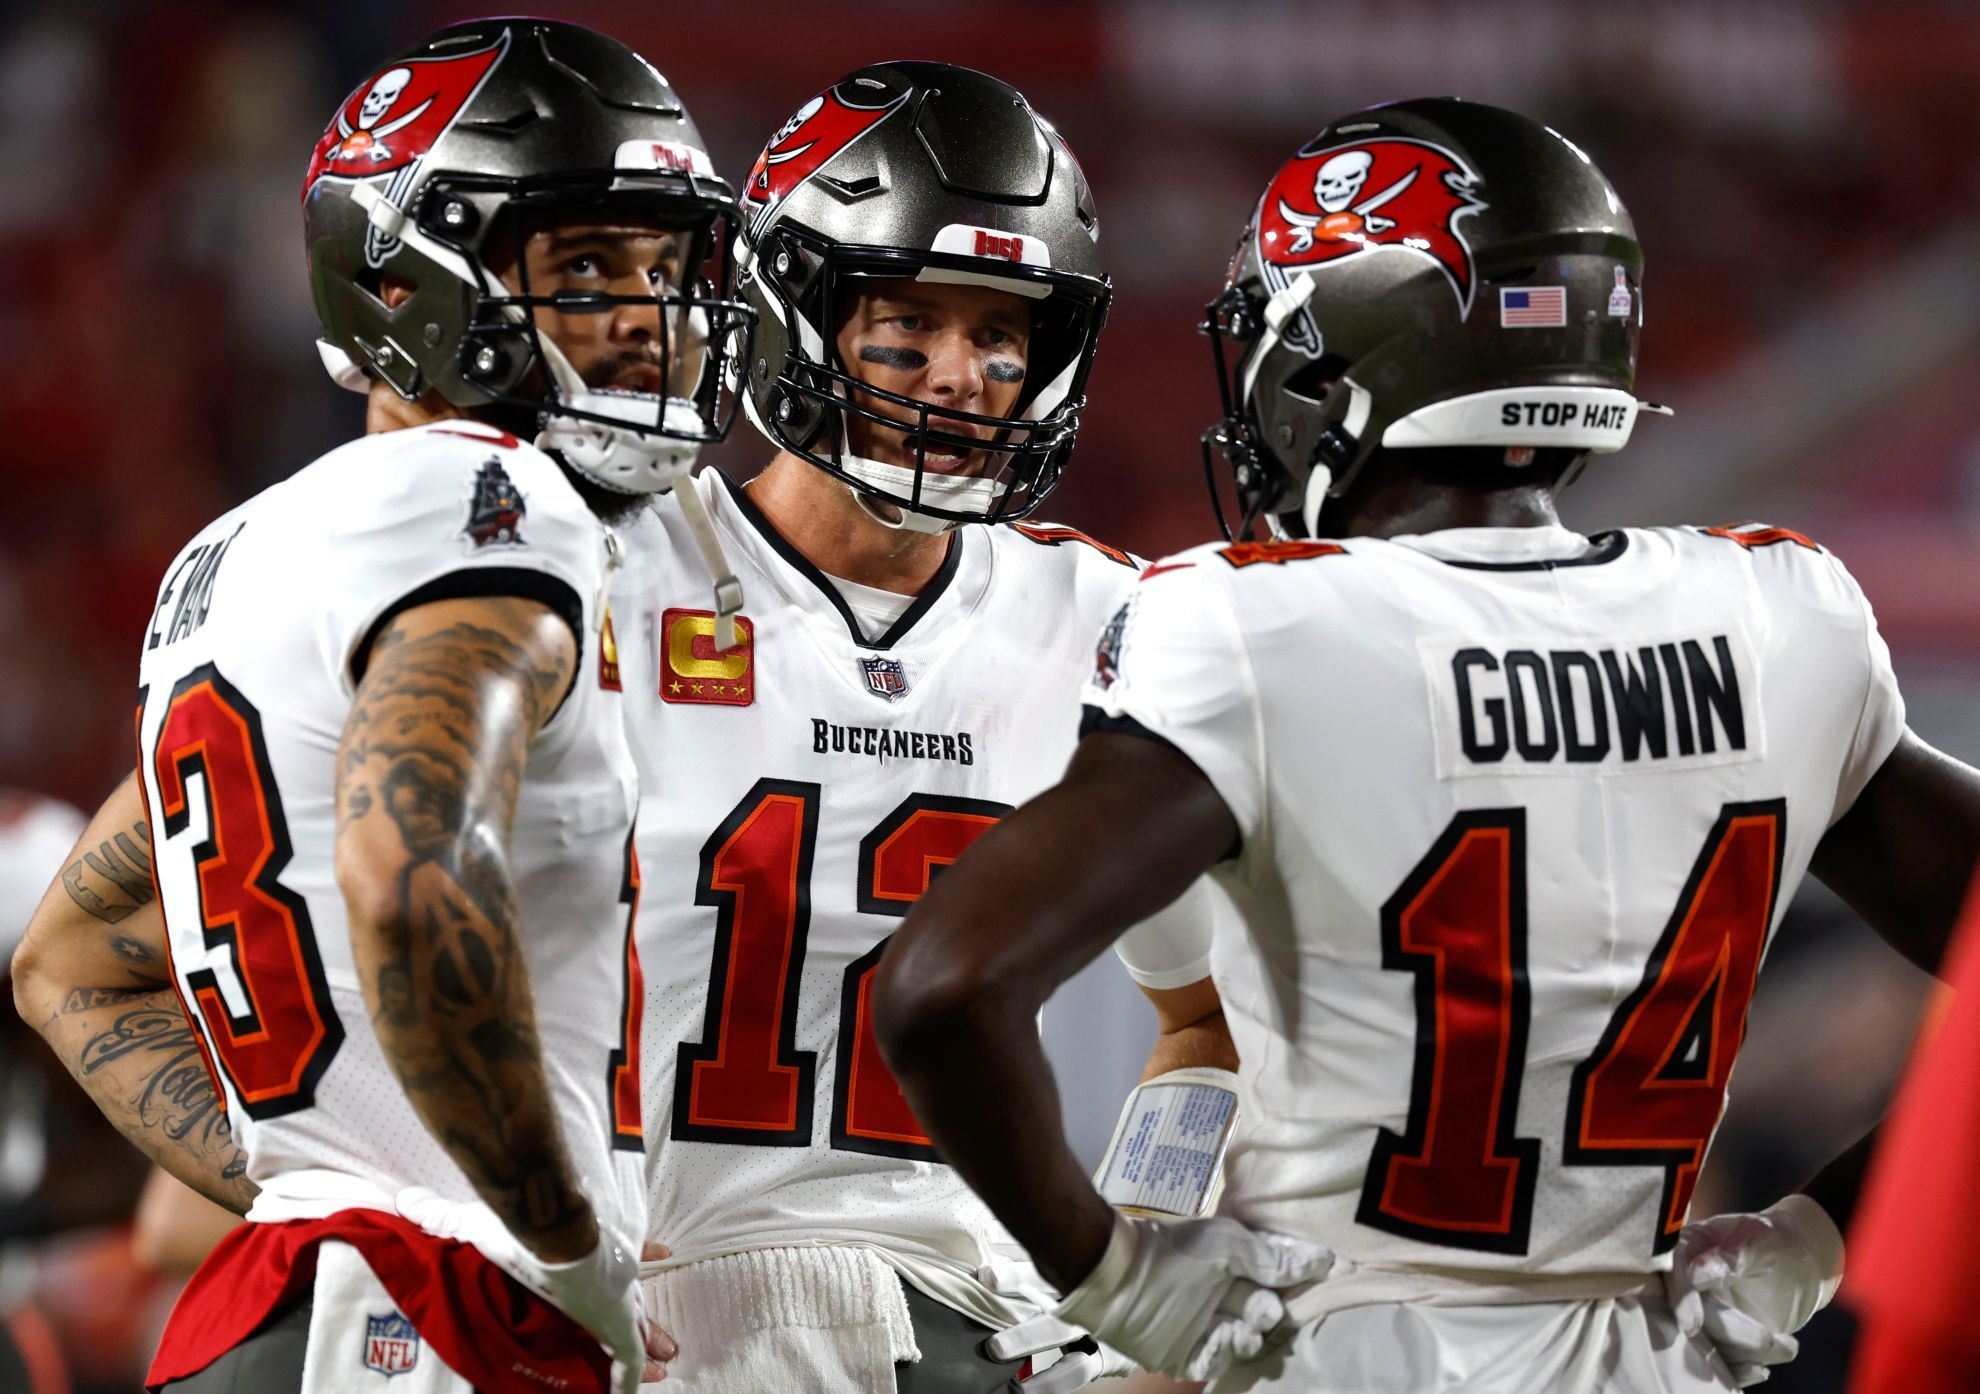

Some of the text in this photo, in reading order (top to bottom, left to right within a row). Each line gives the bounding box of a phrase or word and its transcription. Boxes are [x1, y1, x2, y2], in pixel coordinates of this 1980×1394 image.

[1502, 402, 1627, 430] STOP HATE
[147, 520, 247, 651] EVAN
[669, 616, 748, 680] C
[870, 672, 904, 692] NFL
[1452, 635, 1747, 763] GODWIN
[811, 717, 974, 766] BUCCANEERS
[1354, 797, 1787, 1257] 14
[368, 1339, 414, 1370] NFL
